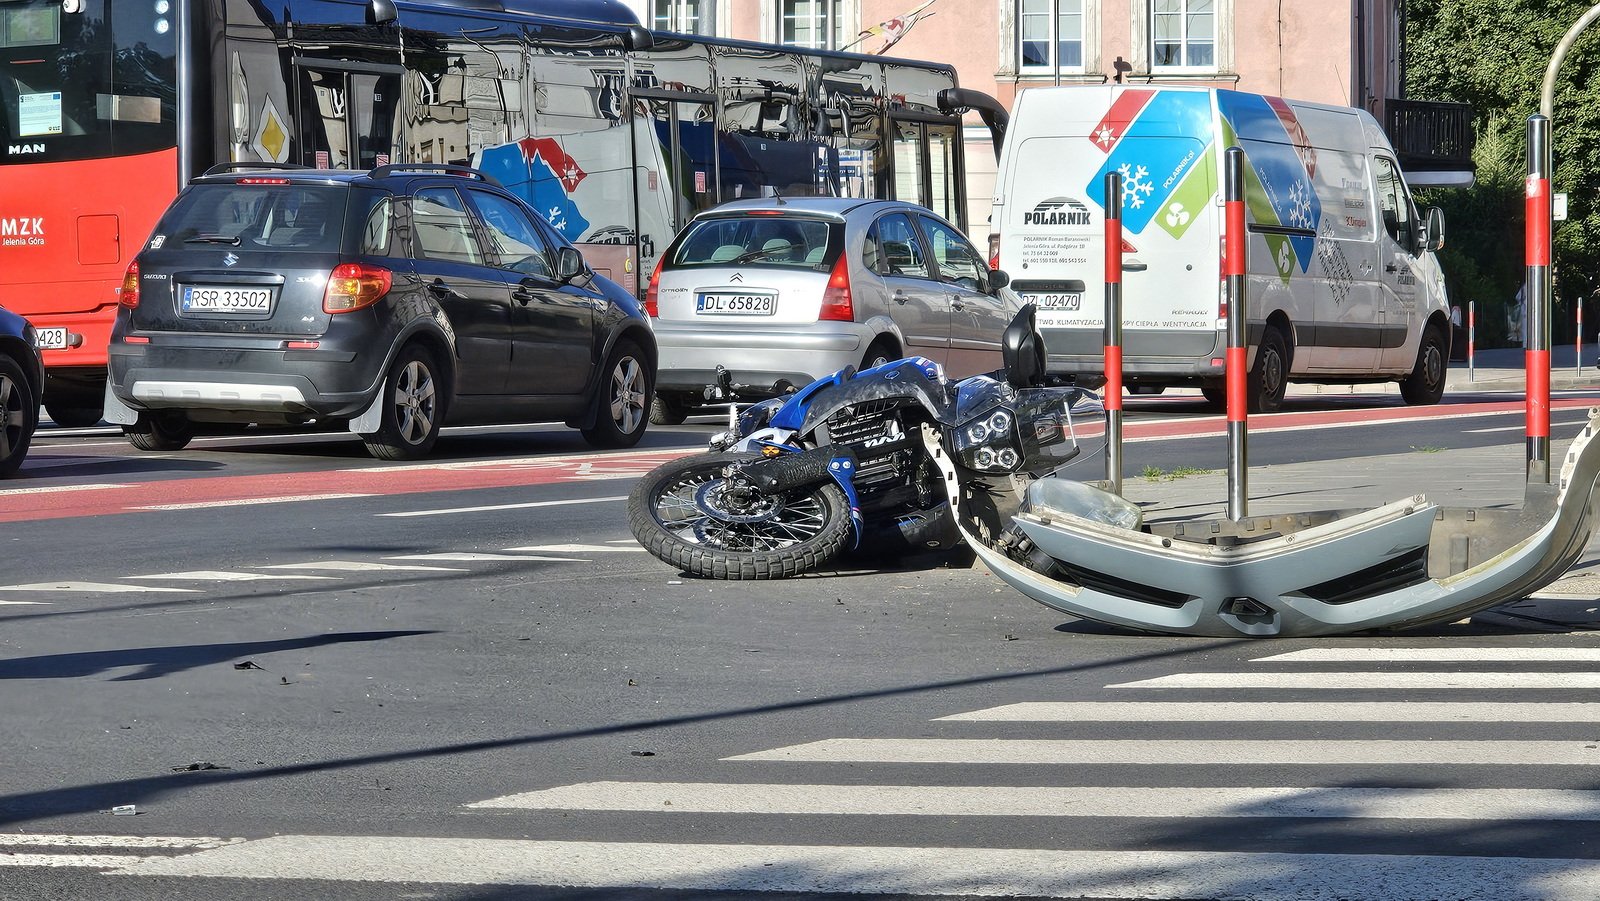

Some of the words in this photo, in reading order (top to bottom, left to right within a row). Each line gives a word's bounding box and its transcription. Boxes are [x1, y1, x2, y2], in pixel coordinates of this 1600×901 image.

[8, 143, 46, 155] MAN
[1162, 150, 1195, 189] POLARNIK.pl
[1024, 212, 1091, 225] POLARNIK
[1, 217, 45, 236] MZK
[2, 237, 26, 246] Jelenia
[28, 236, 45, 246] Góra
[191, 290, 218, 307] RSR
[222, 291, 267, 308] 33502
[705, 296, 723, 310] DL
[728, 296, 771, 311] 65828
[1044, 295, 1078, 307] 02470
[39, 329, 63, 346] 428
